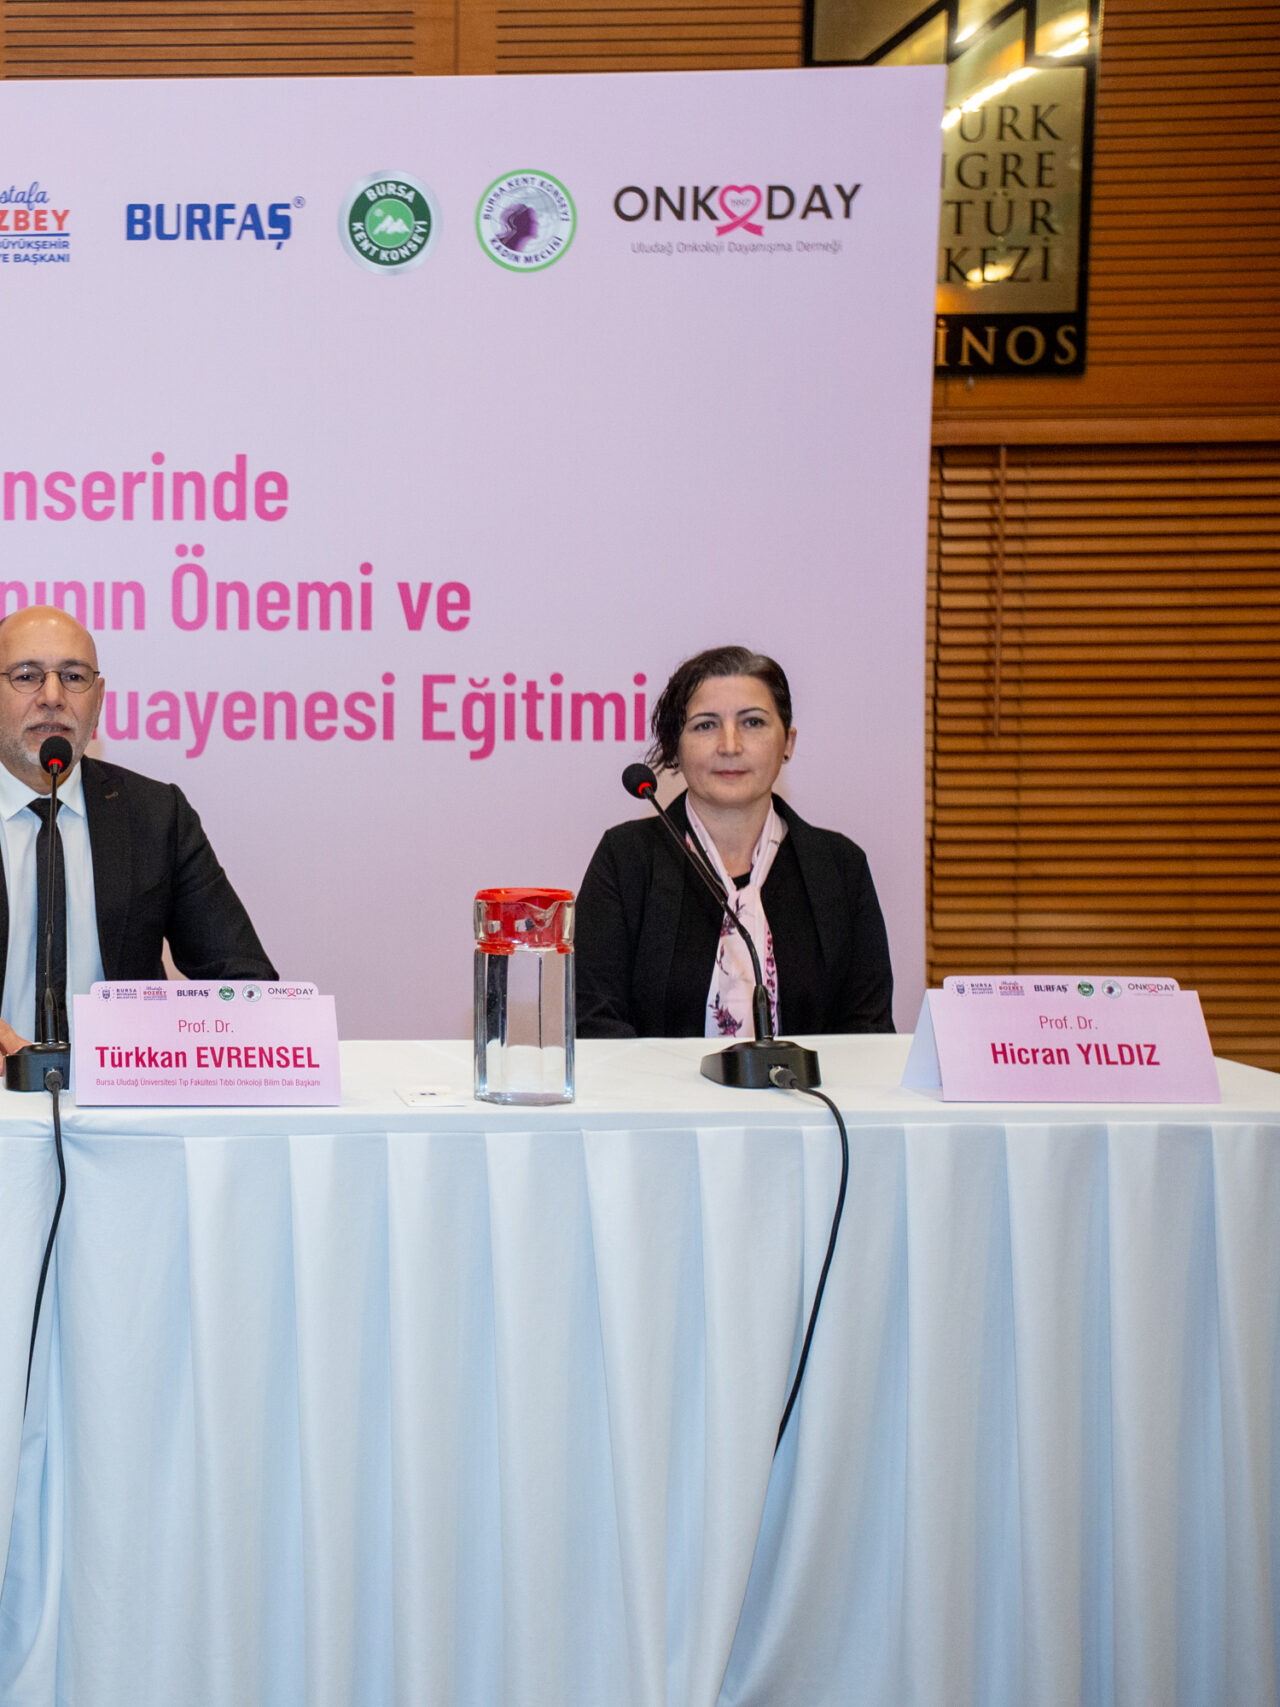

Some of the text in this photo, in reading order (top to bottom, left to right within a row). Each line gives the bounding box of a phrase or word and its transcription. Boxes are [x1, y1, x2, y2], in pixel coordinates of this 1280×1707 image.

[941, 152, 1056, 190] GRE
[365, 182, 416, 203] BURSA
[351, 221, 380, 257] KENT
[171, 543, 374, 632] Önemi
[396, 580, 471, 632] ve
[93, 671, 395, 758] uayenesi
[421, 671, 647, 760] Eğitimi
[178, 1019, 234, 1033] Prof. Dr.
[1038, 1015, 1099, 1031] Prof. Dr.
[94, 1046, 320, 1069] Türkkan EVRENSEL
[990, 1042, 1161, 1067] Hicran YILDIZ
